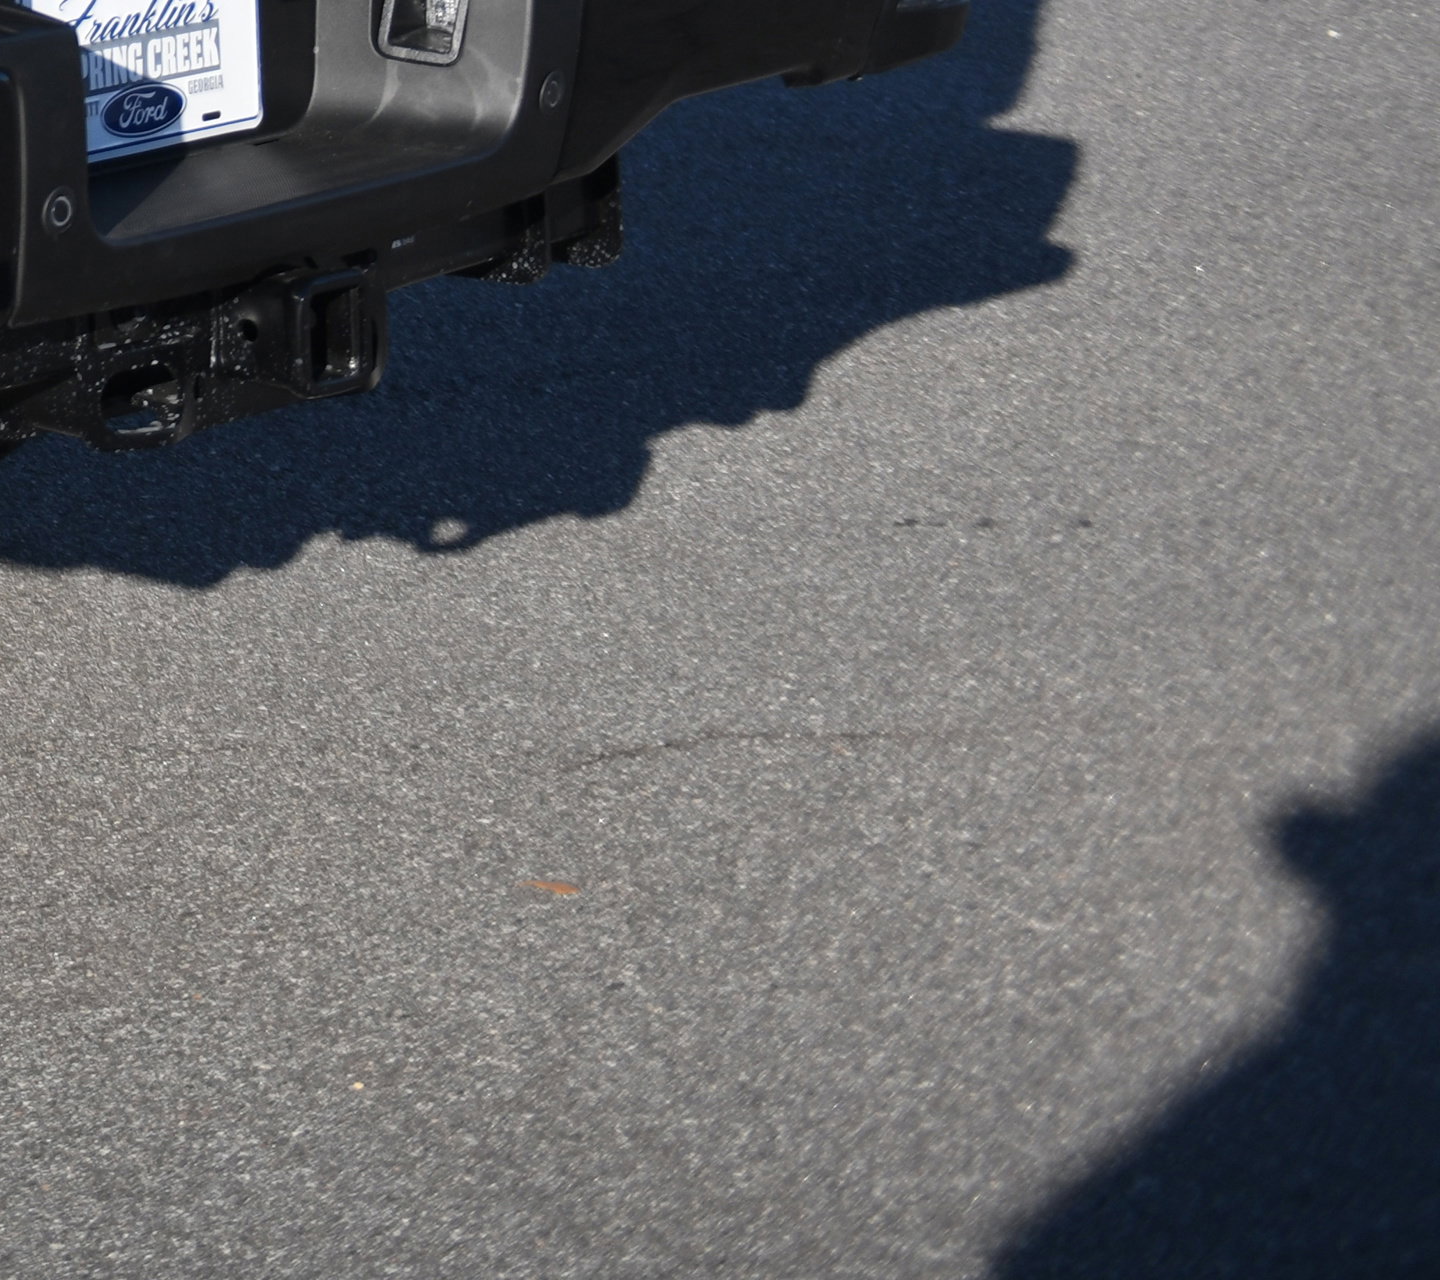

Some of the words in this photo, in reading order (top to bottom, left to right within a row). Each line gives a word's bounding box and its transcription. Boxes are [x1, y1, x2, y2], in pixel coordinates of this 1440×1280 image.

[80, 41, 144, 91] PRING
[147, 26, 220, 80] CREEK
[188, 74, 225, 96] GEORGIA
[119, 90, 169, 129] Ford
